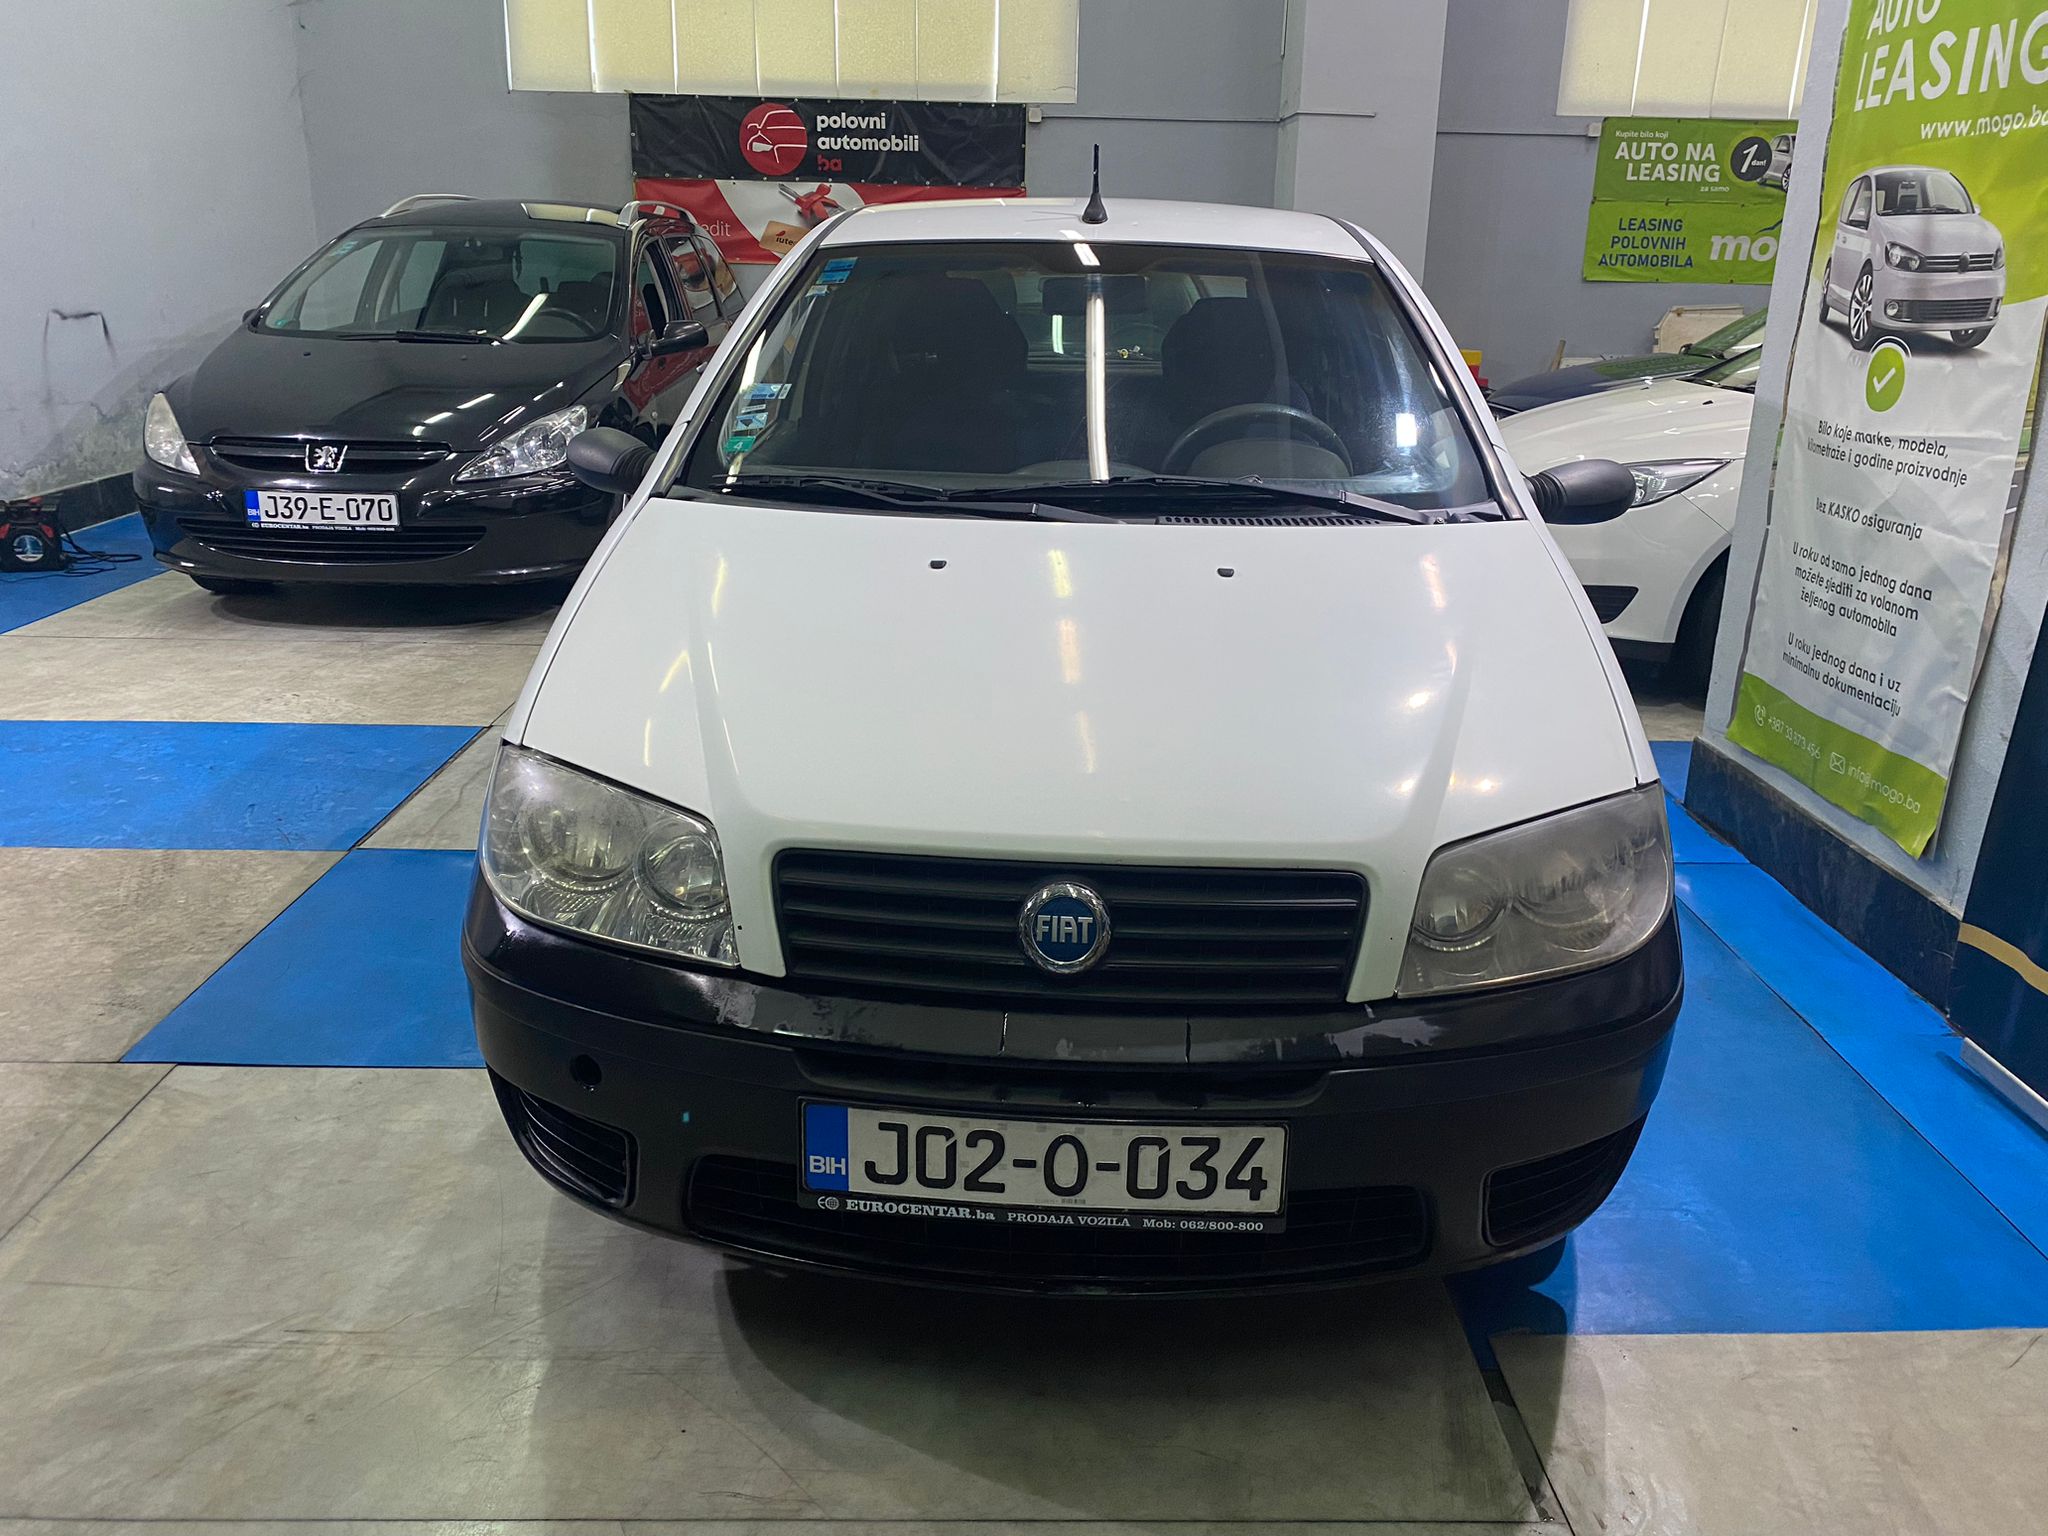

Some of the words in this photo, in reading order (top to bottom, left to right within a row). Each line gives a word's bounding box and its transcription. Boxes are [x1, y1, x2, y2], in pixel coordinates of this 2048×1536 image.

[1853, 9, 2048, 113] LEASING
[816, 112, 886, 132] polovni
[1615, 130, 1638, 139] Kupite
[1640, 130, 1654, 138] bilo
[1655, 131, 1668, 139] koji
[817, 134, 919, 152] automobili
[1614, 141, 1679, 161] AUTO
[1685, 143, 1716, 161] NA
[1740, 144, 1758, 173] 1
[1626, 162, 1720, 182] LEASING
[1618, 217, 1683, 232] LEASING
[1610, 236, 1686, 250] POLOVNIH
[1598, 254, 1693, 268] AUTOMOBILA
[1818, 420, 1832, 436] Bilo
[1833, 423, 1852, 443] koje
[1854, 430, 1895, 450] marke,
[1898, 436, 1949, 459] modela,
[1848, 448, 1853, 463] i
[1853, 452, 1894, 471] godine
[1895, 460, 1968, 488] proizvodnje
[264, 495, 393, 521] J39-E-070
[1827, 501, 1861, 523] KASKO
[1861, 514, 1923, 541] osiguranja
[1792, 541, 1799, 555] U
[1799, 546, 1819, 563] roku
[1820, 554, 1830, 568] od
[1831, 559, 1856, 577] samo
[1858, 565, 1897, 594] jednog
[1899, 580, 1932, 601] dana
[1794, 565, 1824, 587] možete
[1824, 577, 1853, 598] sjediti
[1856, 589, 1867, 603] za
[1870, 593, 1919, 621] volanom
[1800, 586, 1835, 616] željenog
[1839, 605, 1897, 637] automobila
[1788, 631, 1795, 645] U
[1795, 638, 1811, 655] roku
[1811, 645, 1846, 674] jednog
[1848, 661, 1876, 684] dana
[1879, 672, 1884, 687] i
[1887, 678, 1901, 693] uz
[1782, 651, 1821, 681] minimalnu
[1822, 672, 1901, 717] dokumentaciju
[1848, 762, 1921, 814] info@mogo.ba
[1036, 915, 1094, 944] FIAT
[809, 1155, 847, 1176] BIH
[864, 1121, 1268, 1201] J02-O-034
[846, 1199, 995, 1221] EUROCENTAR.ba
[1007, 1212, 1074, 1225] PRODAJA
[1078, 1216, 1131, 1227] VOZILA
[1143, 1218, 1176, 1229] Mob:
[1180, 1220, 1264, 1231] 062/800-800
